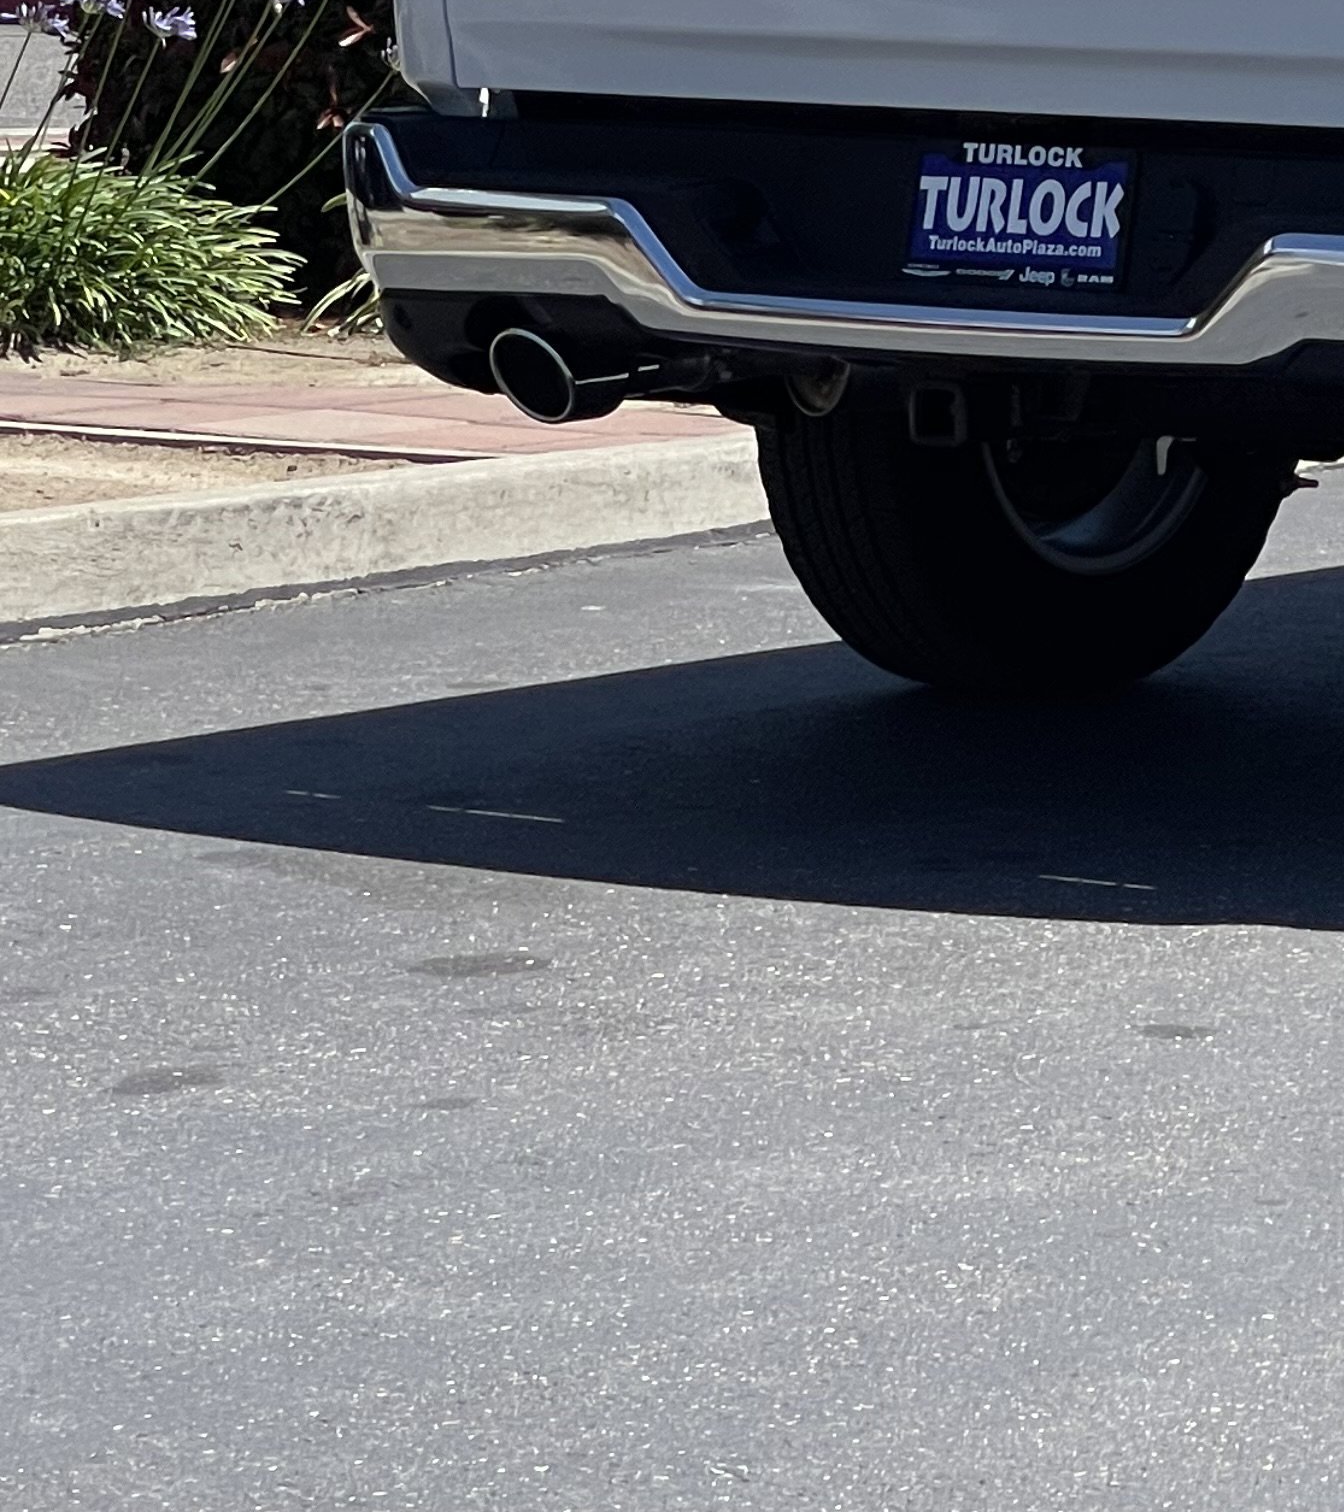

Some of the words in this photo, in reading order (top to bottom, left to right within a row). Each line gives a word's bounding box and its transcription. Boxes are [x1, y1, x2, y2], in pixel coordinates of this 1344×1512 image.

[963, 142, 1084, 169] TURLOCK
[919, 175, 1125, 239] TURLOCK
[928, 235, 1102, 257] TurlockAutoPlaza.com
[1018, 266, 1056, 286] Jeep
[1076, 274, 1114, 284] RAM
